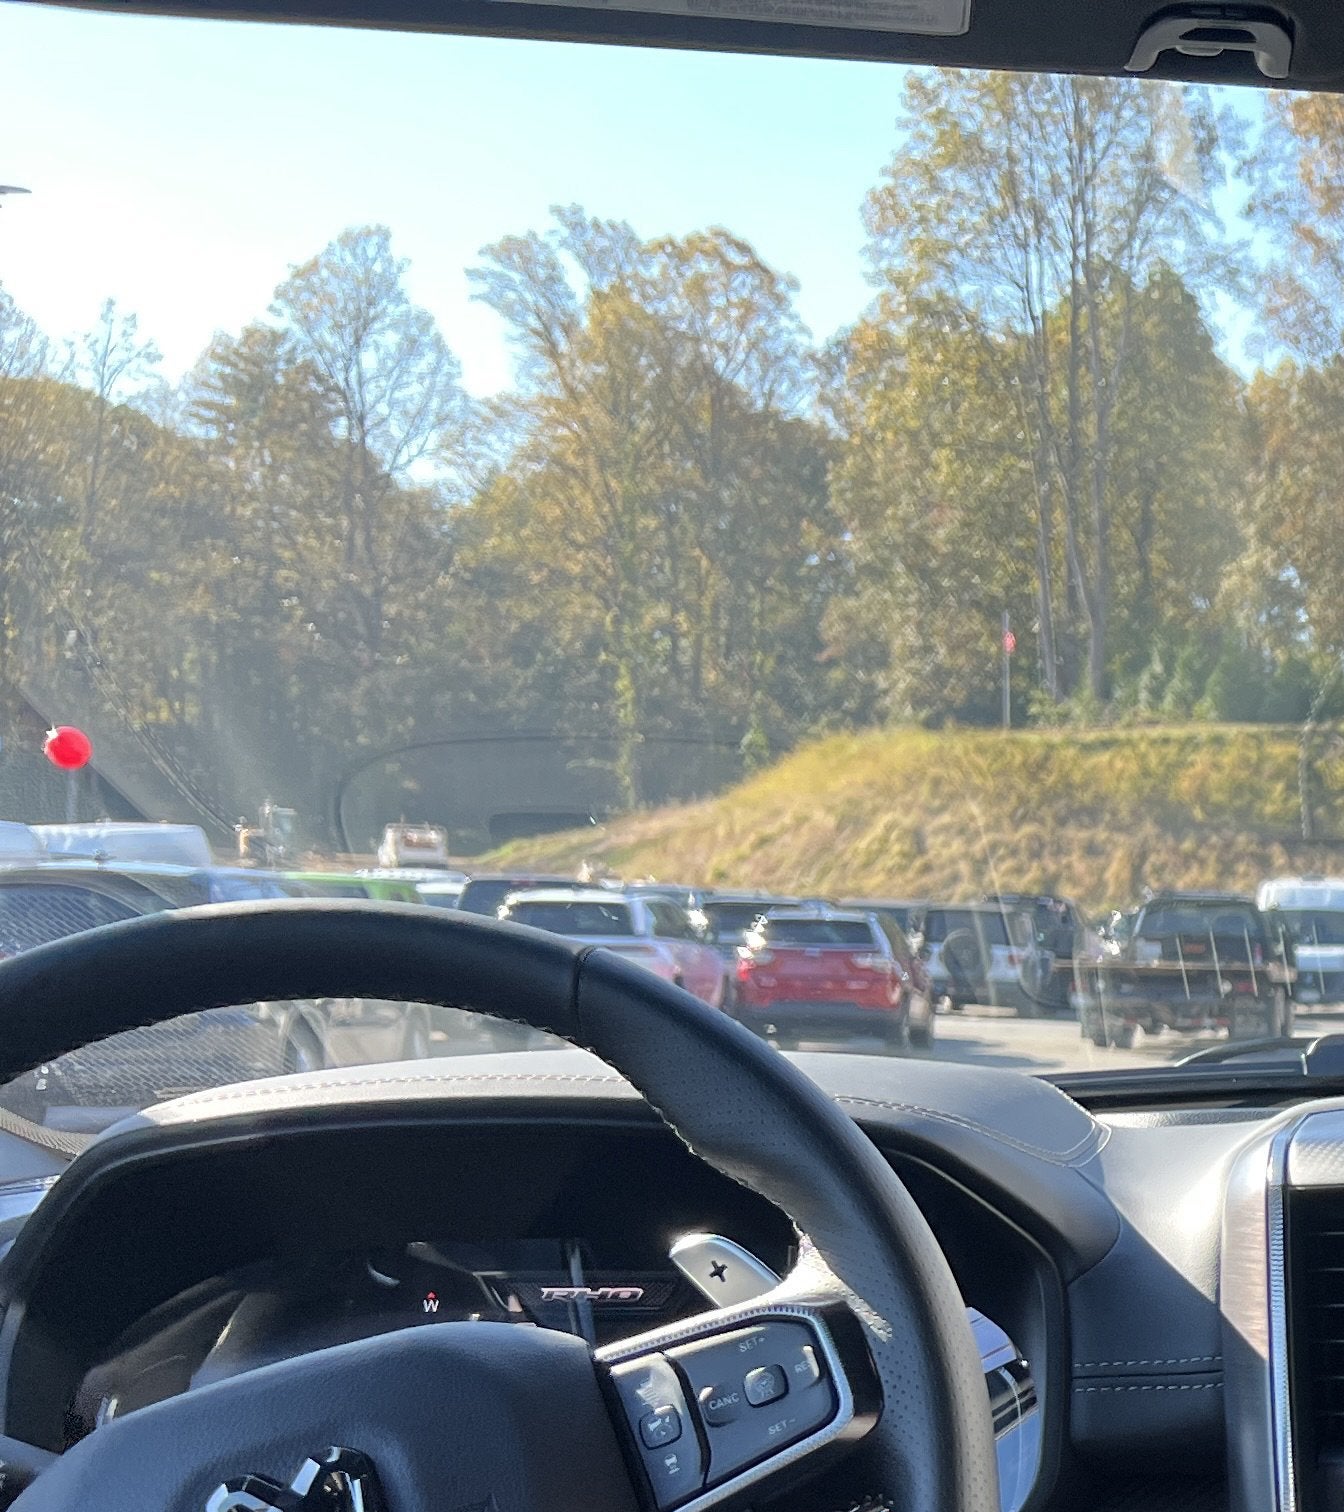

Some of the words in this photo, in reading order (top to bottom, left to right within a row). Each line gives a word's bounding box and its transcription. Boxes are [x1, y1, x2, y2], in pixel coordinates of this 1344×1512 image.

[541, 1286, 645, 1302] RHO
[423, 1299, 439, 1313] W
[709, 1392, 740, 1411] CANC
